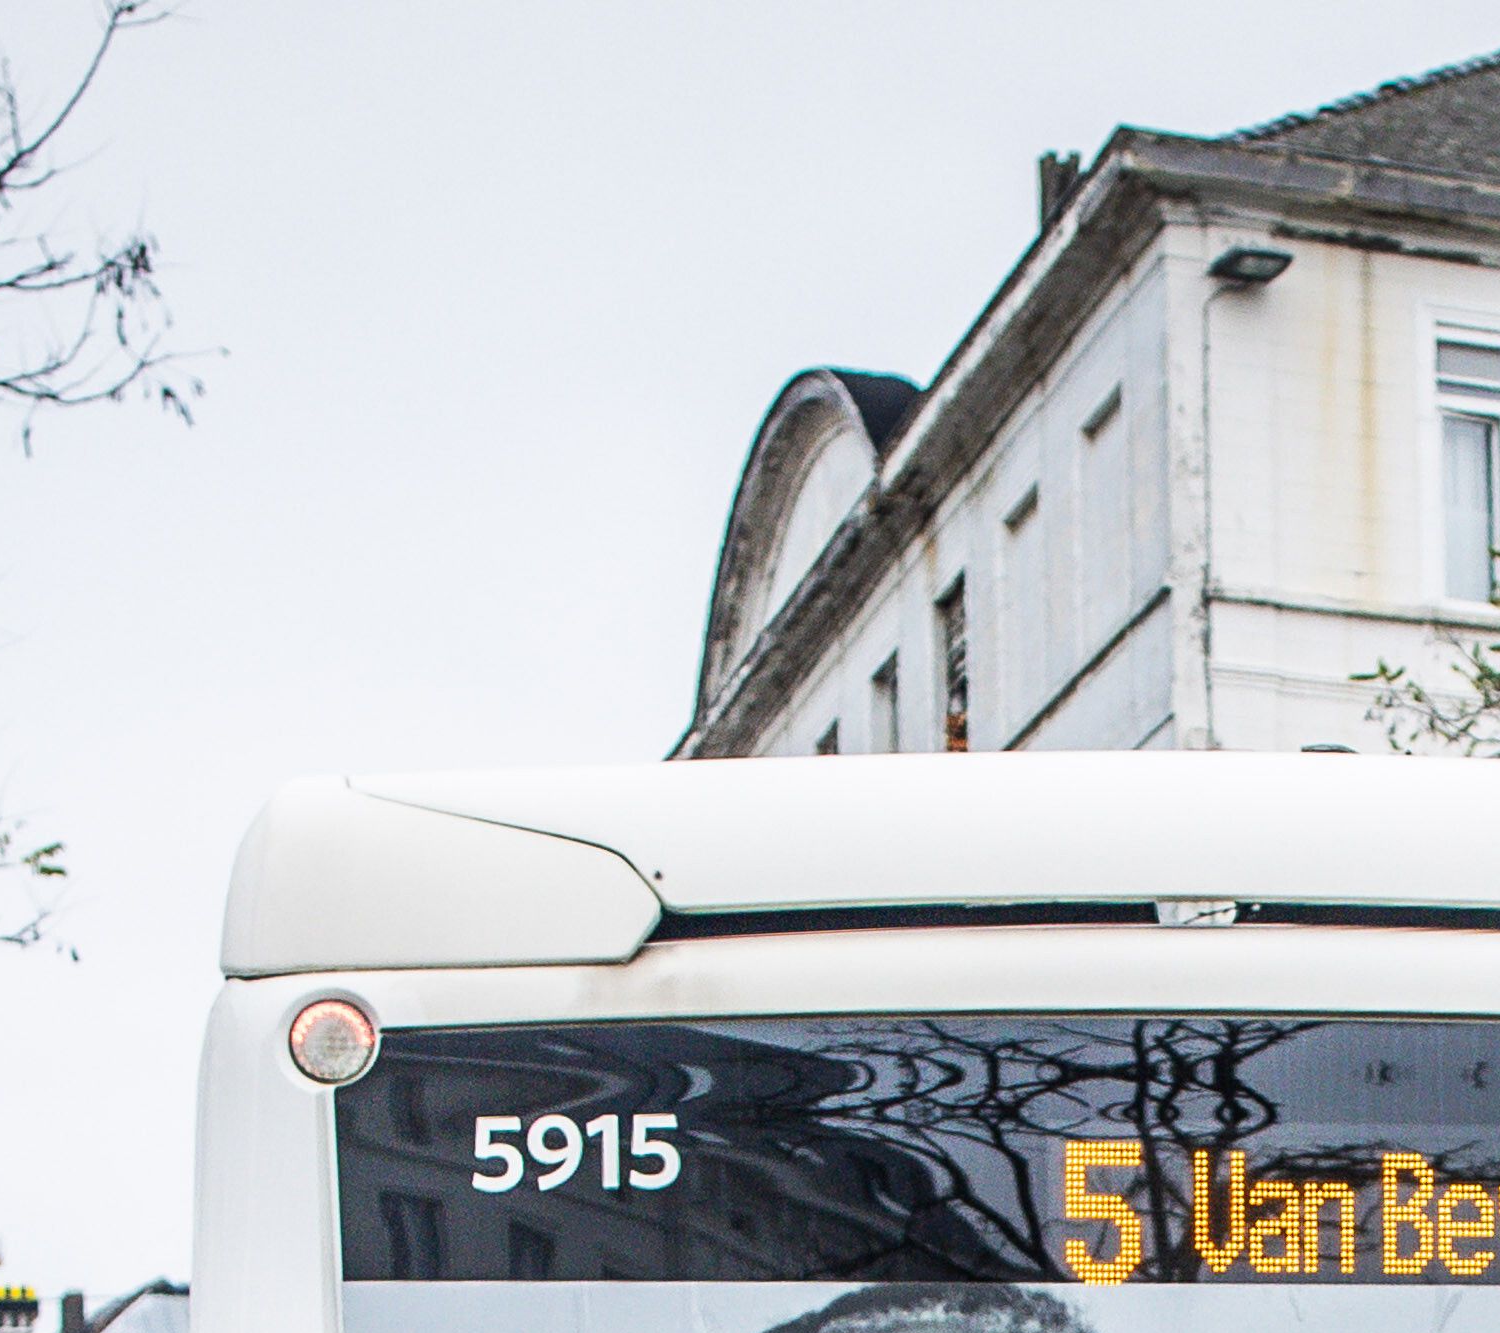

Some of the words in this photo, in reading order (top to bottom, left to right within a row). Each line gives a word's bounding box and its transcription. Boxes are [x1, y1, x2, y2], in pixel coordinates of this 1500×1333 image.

[471, 1113, 682, 1193] 5915
[1064, 1140, 1142, 1286] 5
[1193, 1150, 1355, 1275] Van
